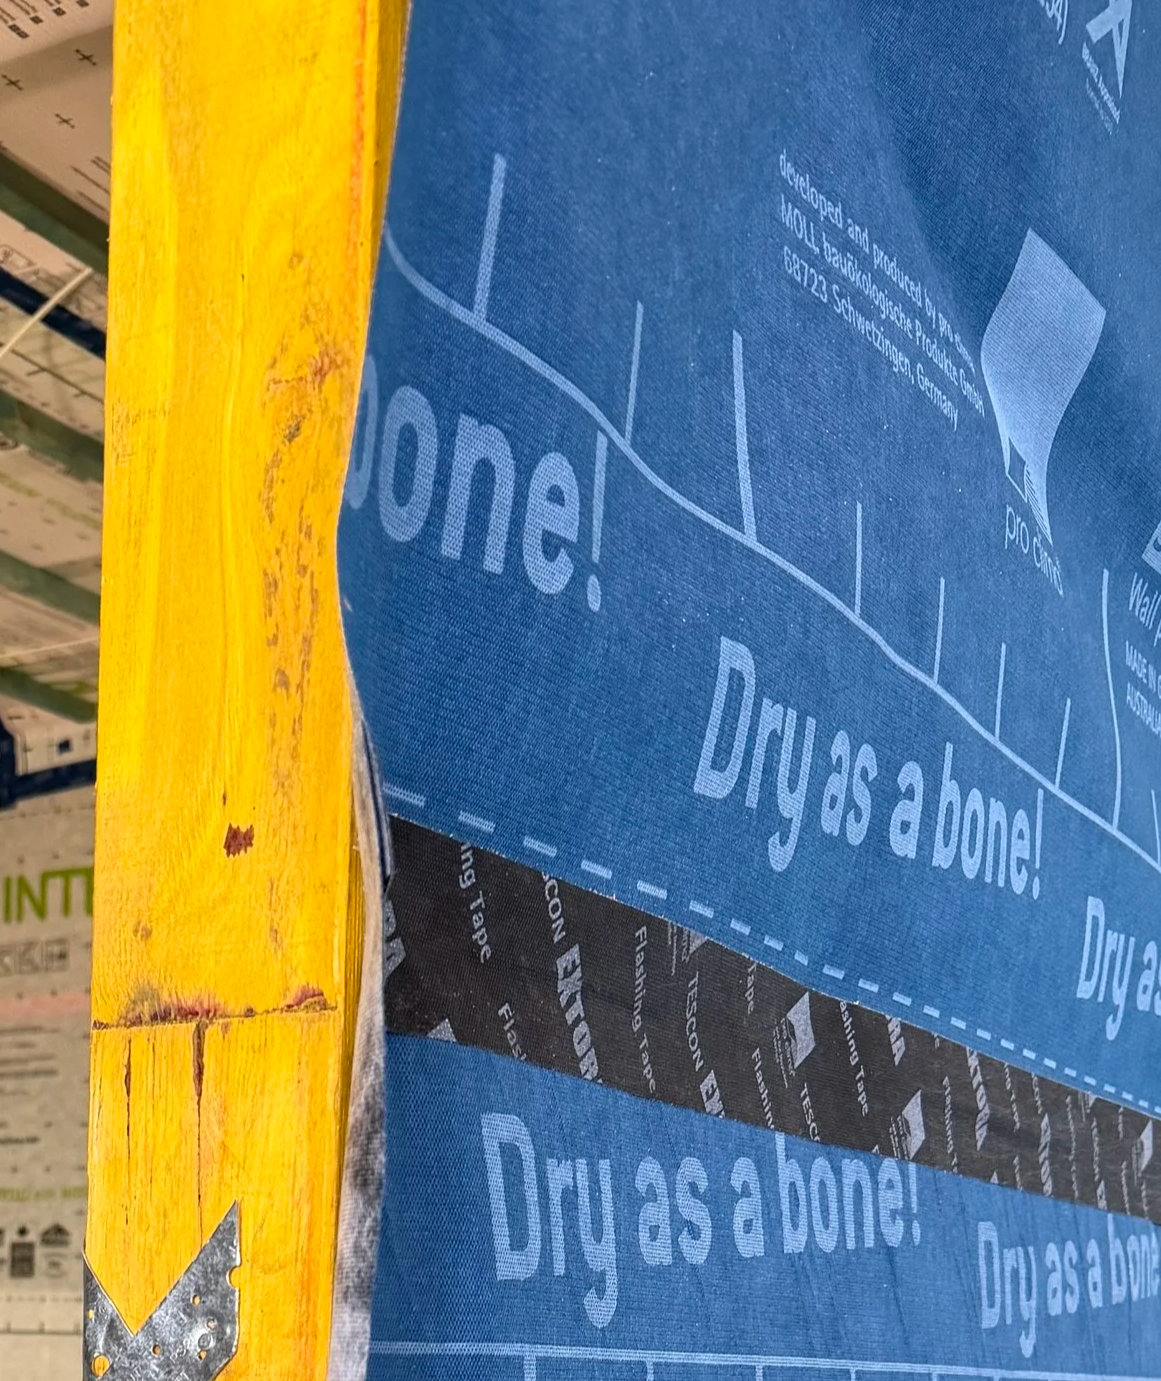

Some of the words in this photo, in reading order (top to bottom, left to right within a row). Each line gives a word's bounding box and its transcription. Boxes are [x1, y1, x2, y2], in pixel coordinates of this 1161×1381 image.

[779, 148, 843, 229] developed
[847, 217, 869, 254] and
[873, 243, 922, 307] produced
[924, 289, 937, 328] by
[783, 245, 828, 303] 68723
[832, 283, 915, 384] Schwetzingen,
[916, 362, 959, 432] Germany
[915, 318, 958, 386] Produkte
[1004, 504, 1030, 554] pro
[693, 635, 817, 873] Dry
[820, 729, 878, 845] as
[889, 760, 925, 861] a
[930, 742, 1045, 901] bone!
[469, 890, 492, 963] Tape
[631, 926, 648, 1033] Flashing
[1076, 895, 1135, 1041] Dry
[555, 943, 604, 1083] EXTOR
[639, 1033, 657, 1092] Tape
[685, 971, 705, 1071] TESCON
[839, 1000, 860, 1066] ashing
[855, 1065, 869, 1117] Tape
[886, 1015, 906, 1067] RA
[1038, 1113, 1055, 1198] EXTOR
[479, 1111, 620, 1329] Dry
[637, 1154, 713, 1266] as
[731, 1156, 766, 1260] a
[775, 1132, 923, 1257] bone!
[977, 1220, 1037, 1359] Dry
[1045, 1240, 1080, 1317] as
[1086, 1238, 1104, 1309] a
